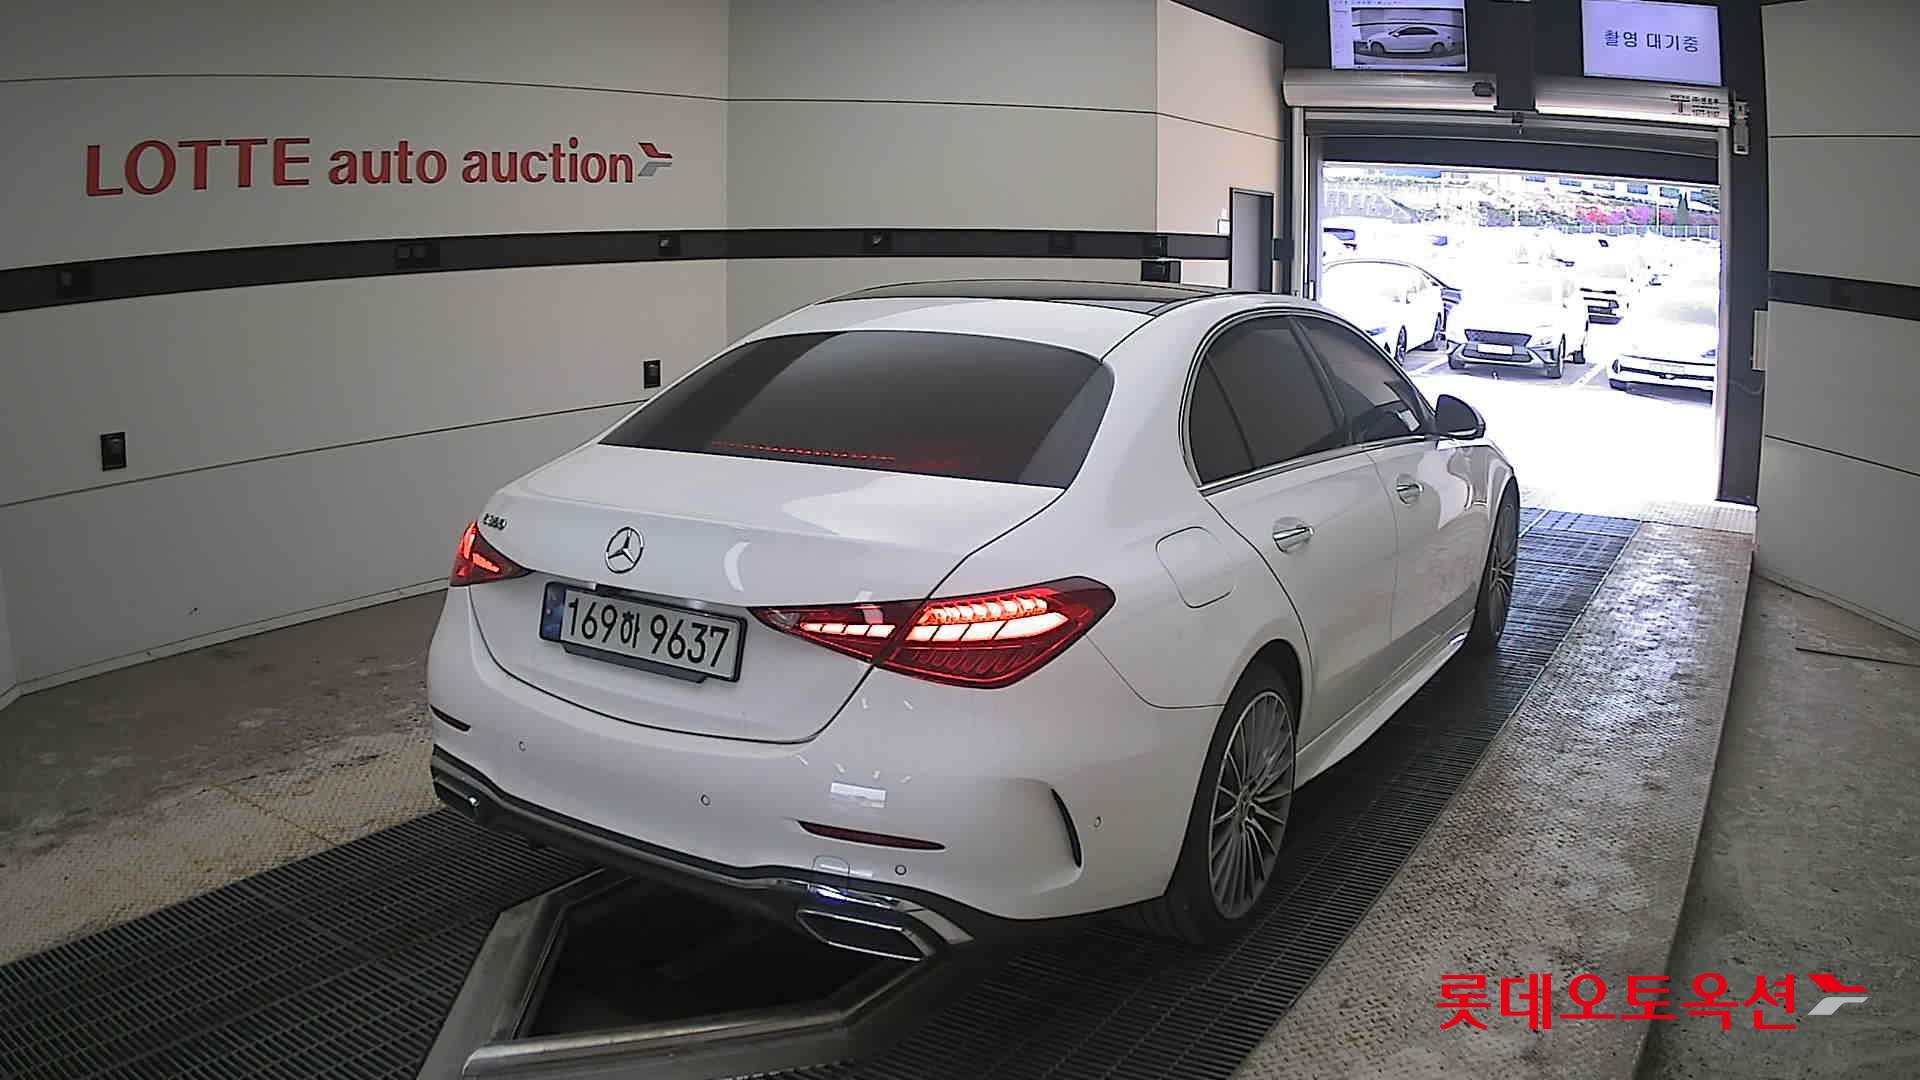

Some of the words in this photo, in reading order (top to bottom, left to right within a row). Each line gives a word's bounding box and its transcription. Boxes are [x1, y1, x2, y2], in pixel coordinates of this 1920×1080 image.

[1646, 33, 1698, 52] 대기중
[86, 137, 311, 196] LOTTE
[328, 140, 448, 185] auto
[462, 136, 633, 185] auction
[567, 598, 641, 648] 169하
[650, 613, 731, 667] 9637
